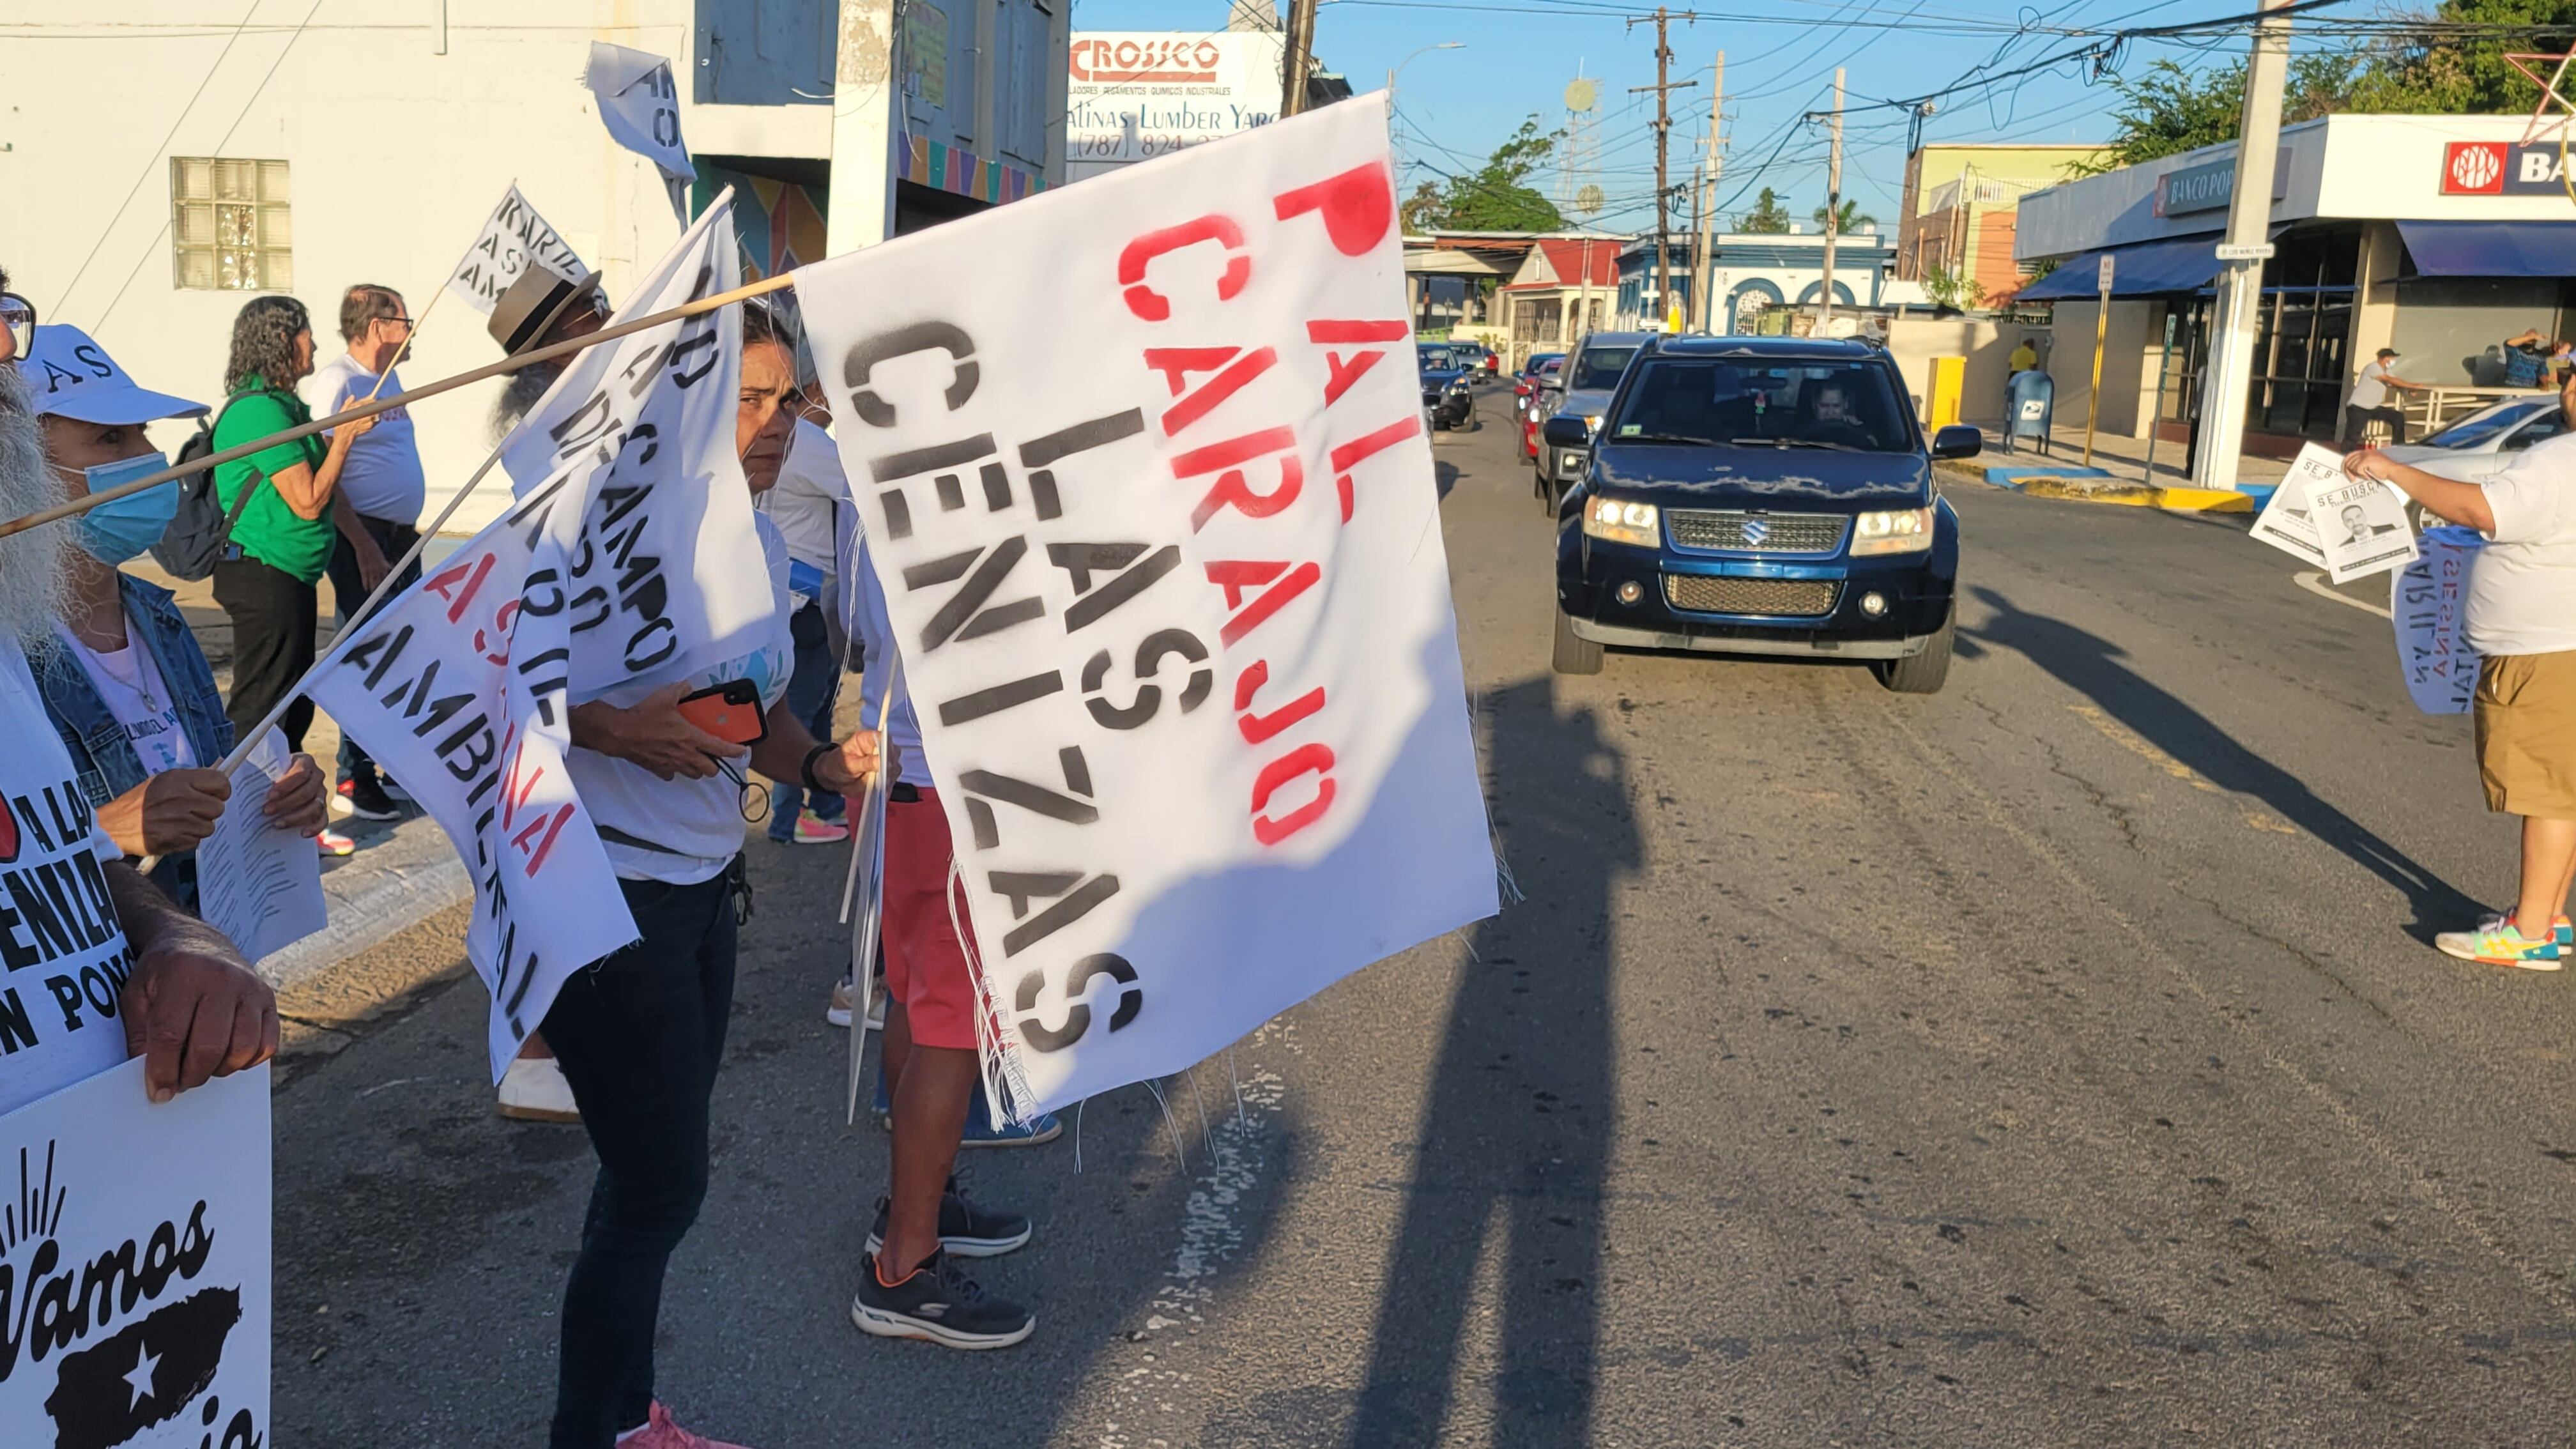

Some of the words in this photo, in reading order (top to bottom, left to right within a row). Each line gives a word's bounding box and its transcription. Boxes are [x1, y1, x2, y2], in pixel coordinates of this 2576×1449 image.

[1069, 40, 1220, 82] CROSSCO
[1069, 86, 1098, 95] LADORES
[1186, 87, 1230, 95] INDUSTRIALES
[1077, 132, 1129, 158] (787)
[2170, 175, 2207, 205] BANCO
[2209, 169, 2234, 197] POP
[498, 196, 579, 276] KARIL
[2317, 495, 2333, 507] SE
[1118, 214, 1336, 846] CARAJO
[1018, 406, 1212, 730] LAS
[844, 318, 1142, 1053] CENIZAS
